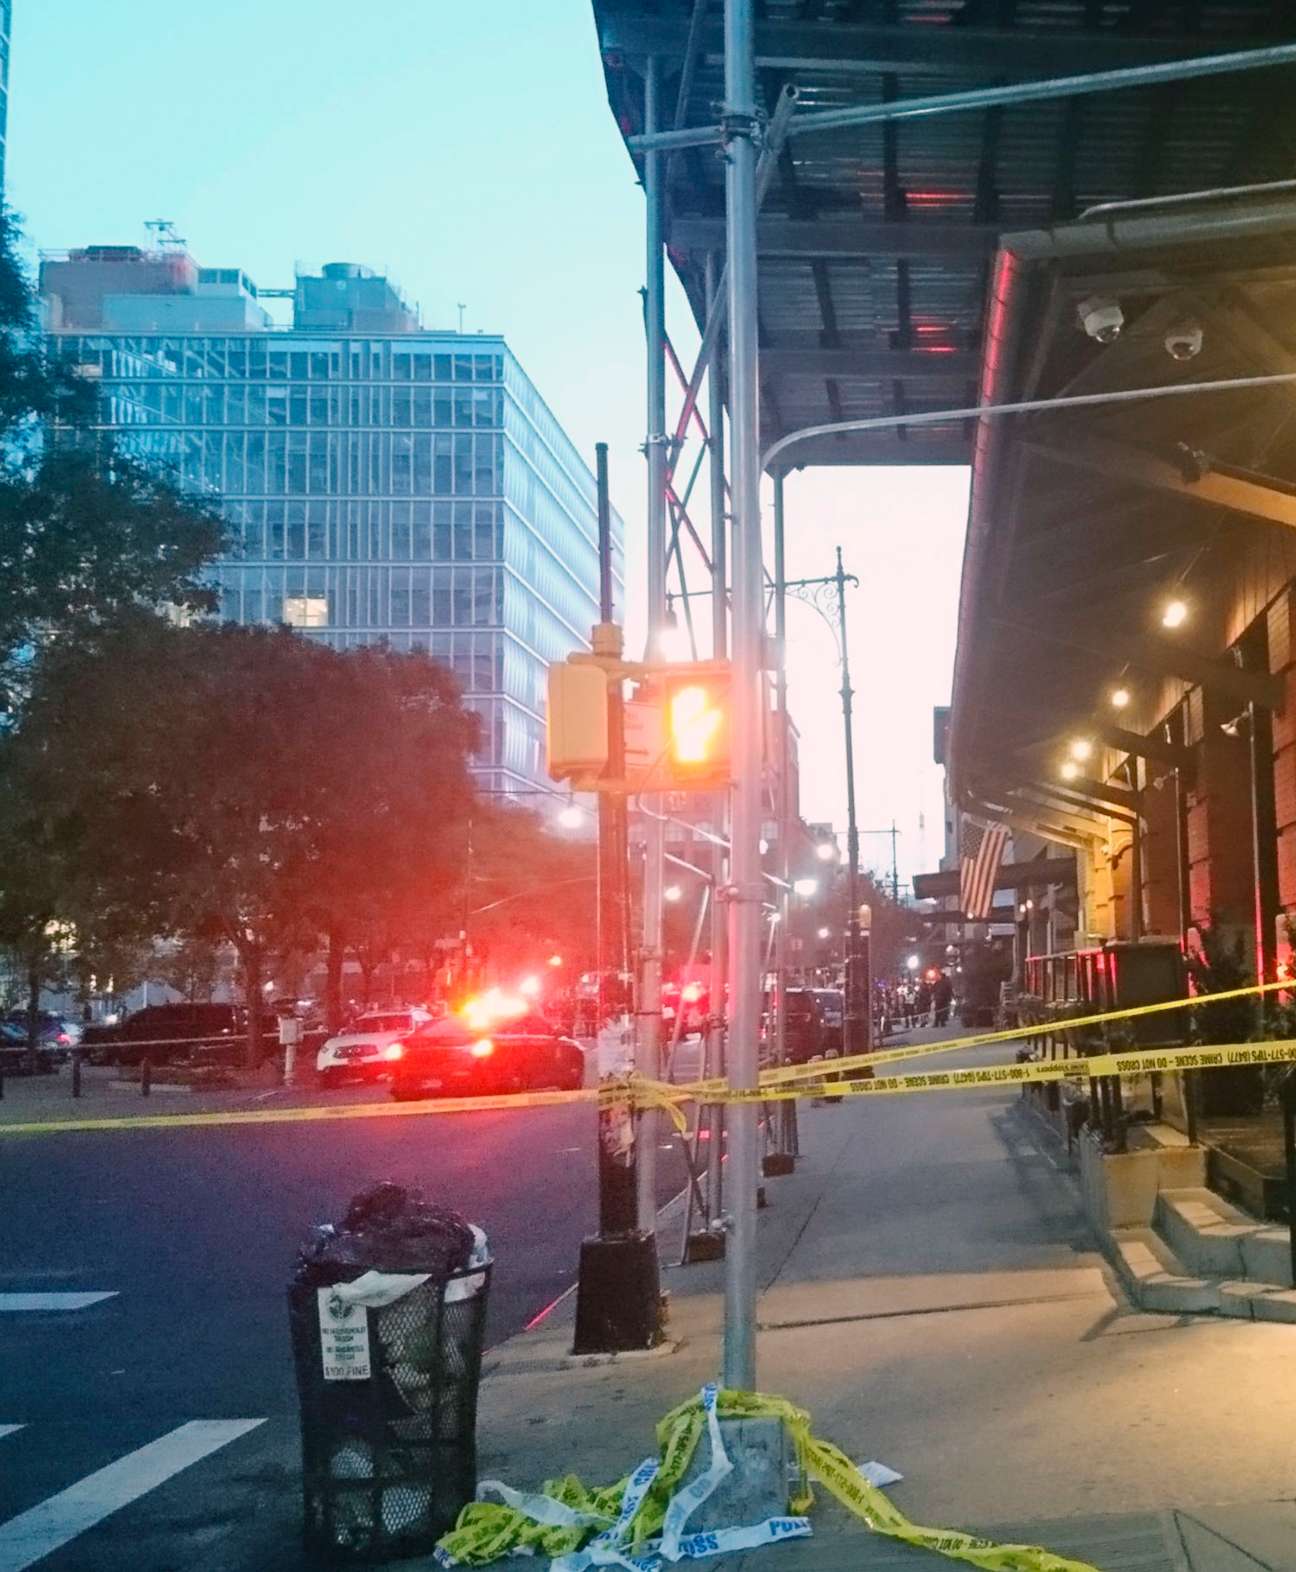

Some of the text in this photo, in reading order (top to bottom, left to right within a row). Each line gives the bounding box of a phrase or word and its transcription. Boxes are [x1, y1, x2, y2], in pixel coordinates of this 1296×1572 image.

[1116, 1058, 1141, 1072] CROSS
[1141, 1058, 1156, 1071] NOT
[1156, 1057, 1168, 1070] DO
[1173, 1055, 1199, 1069] SCENE
[1201, 1053, 1223, 1066] CRIME
[851, 1080, 873, 1092] CROSS
[873, 1079, 887, 1091] NOT
[888, 1078, 898, 1089] DO
[904, 1075, 927, 1088] SCENE
[927, 1074, 949, 1086] CRIME
